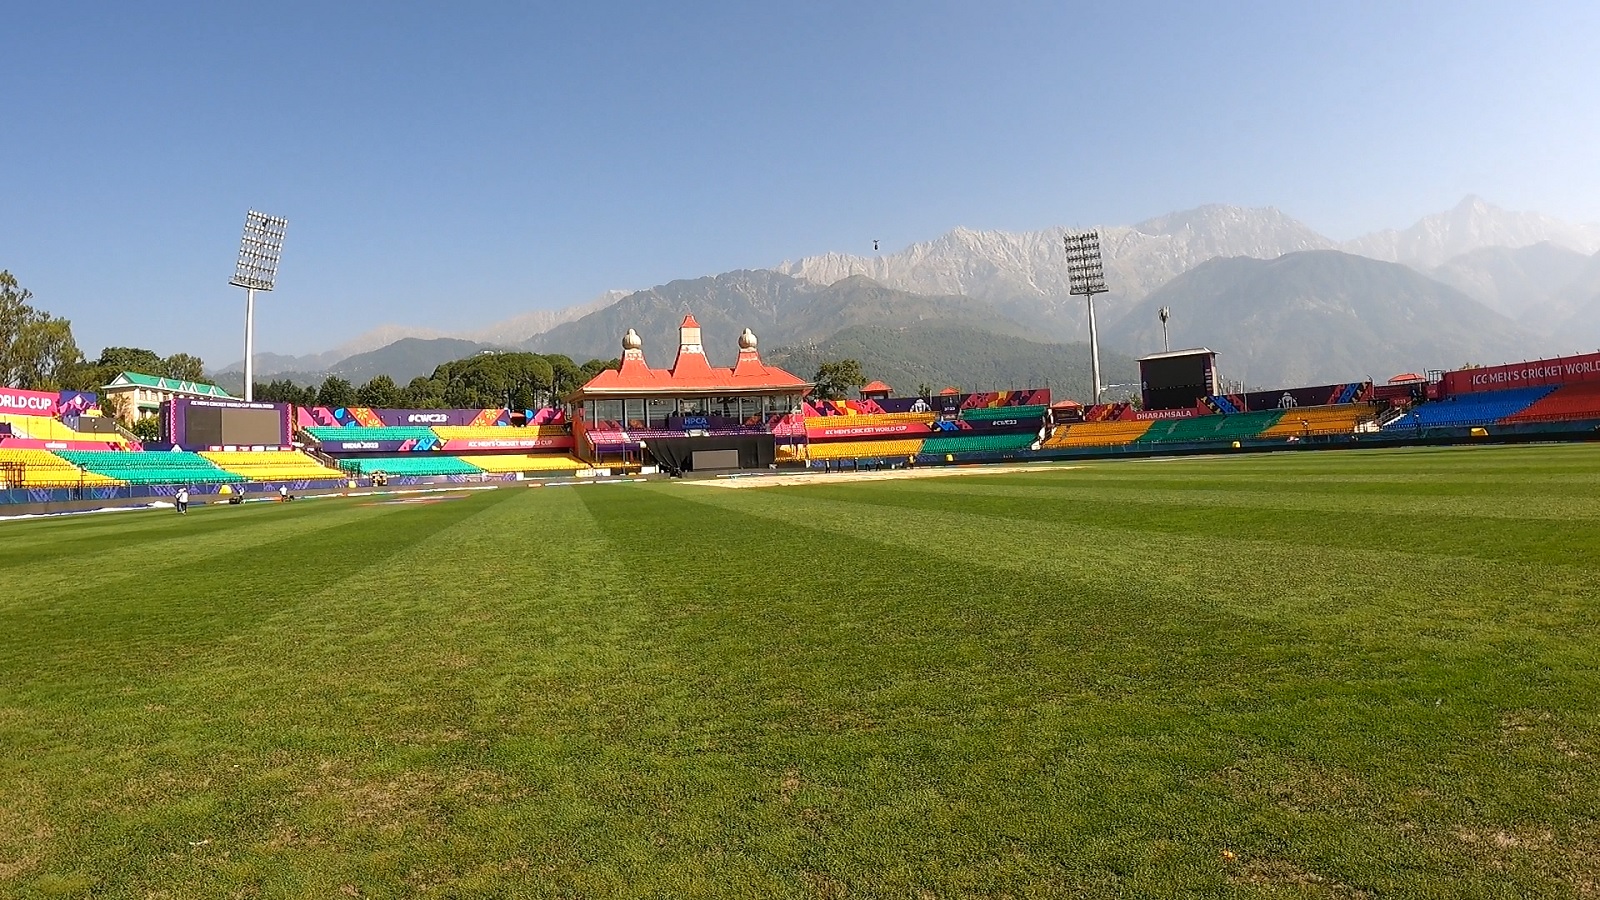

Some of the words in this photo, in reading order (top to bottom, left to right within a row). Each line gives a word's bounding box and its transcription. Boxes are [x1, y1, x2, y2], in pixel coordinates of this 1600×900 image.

[1472, 374, 1488, 385] ICC
[1489, 371, 1520, 383] MEN'S
[1521, 365, 1563, 379] CRICKET
[28, 396, 52, 410] CUP
[408, 414, 447, 423] #CWC23
[1136, 410, 1192, 420] DHARAMSALA
[684, 417, 707, 425] HPCA
